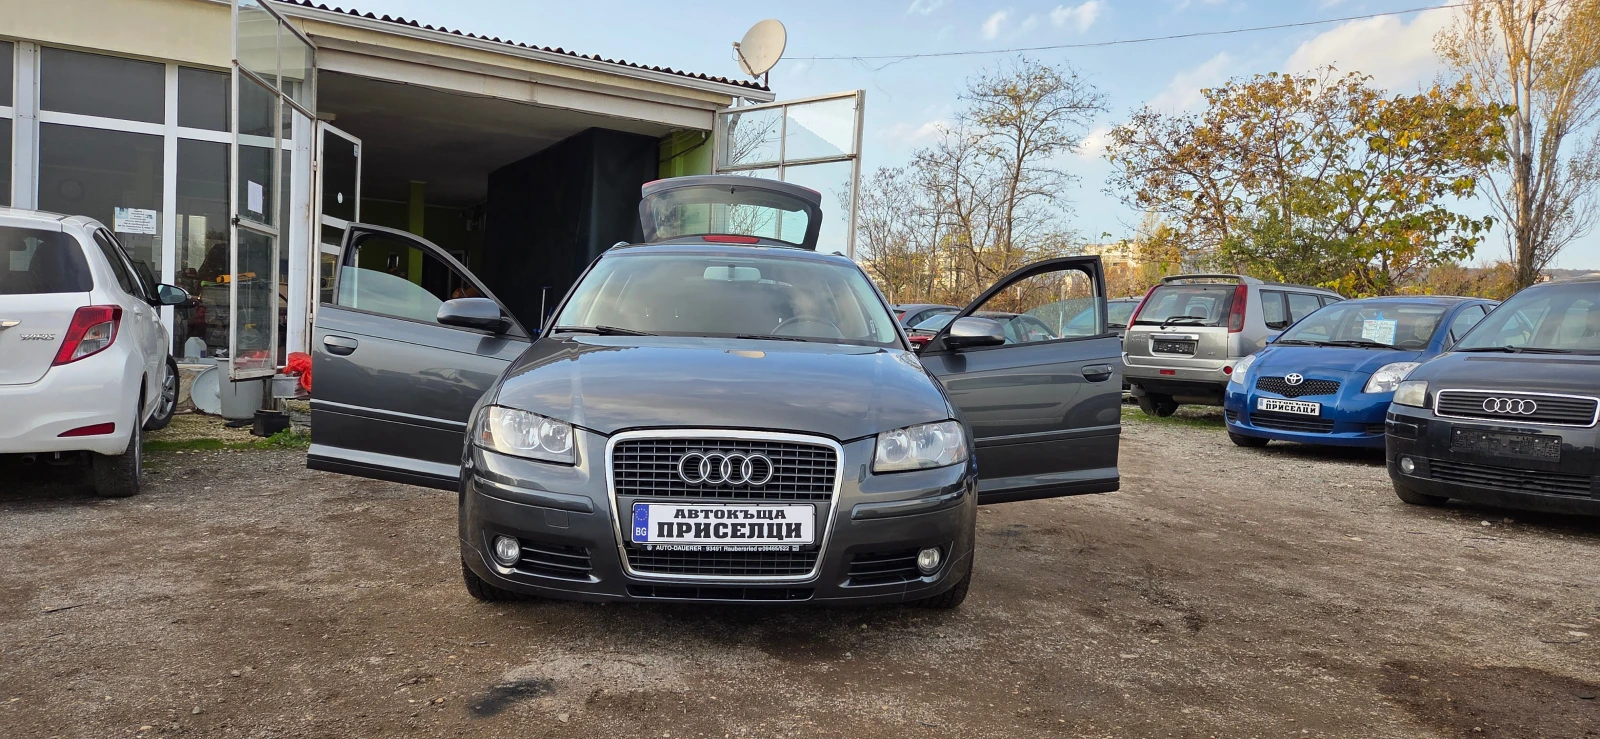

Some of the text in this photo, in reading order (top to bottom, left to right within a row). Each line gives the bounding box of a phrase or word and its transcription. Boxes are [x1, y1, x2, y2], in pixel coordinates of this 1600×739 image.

[1265, 403, 1317, 414] ПРИСЕЛЦИ
[674, 509, 787, 520] АВТОКЪЩА
[635, 527, 647, 536] BG
[657, 522, 802, 540] ПРИСЕЛЦИ
